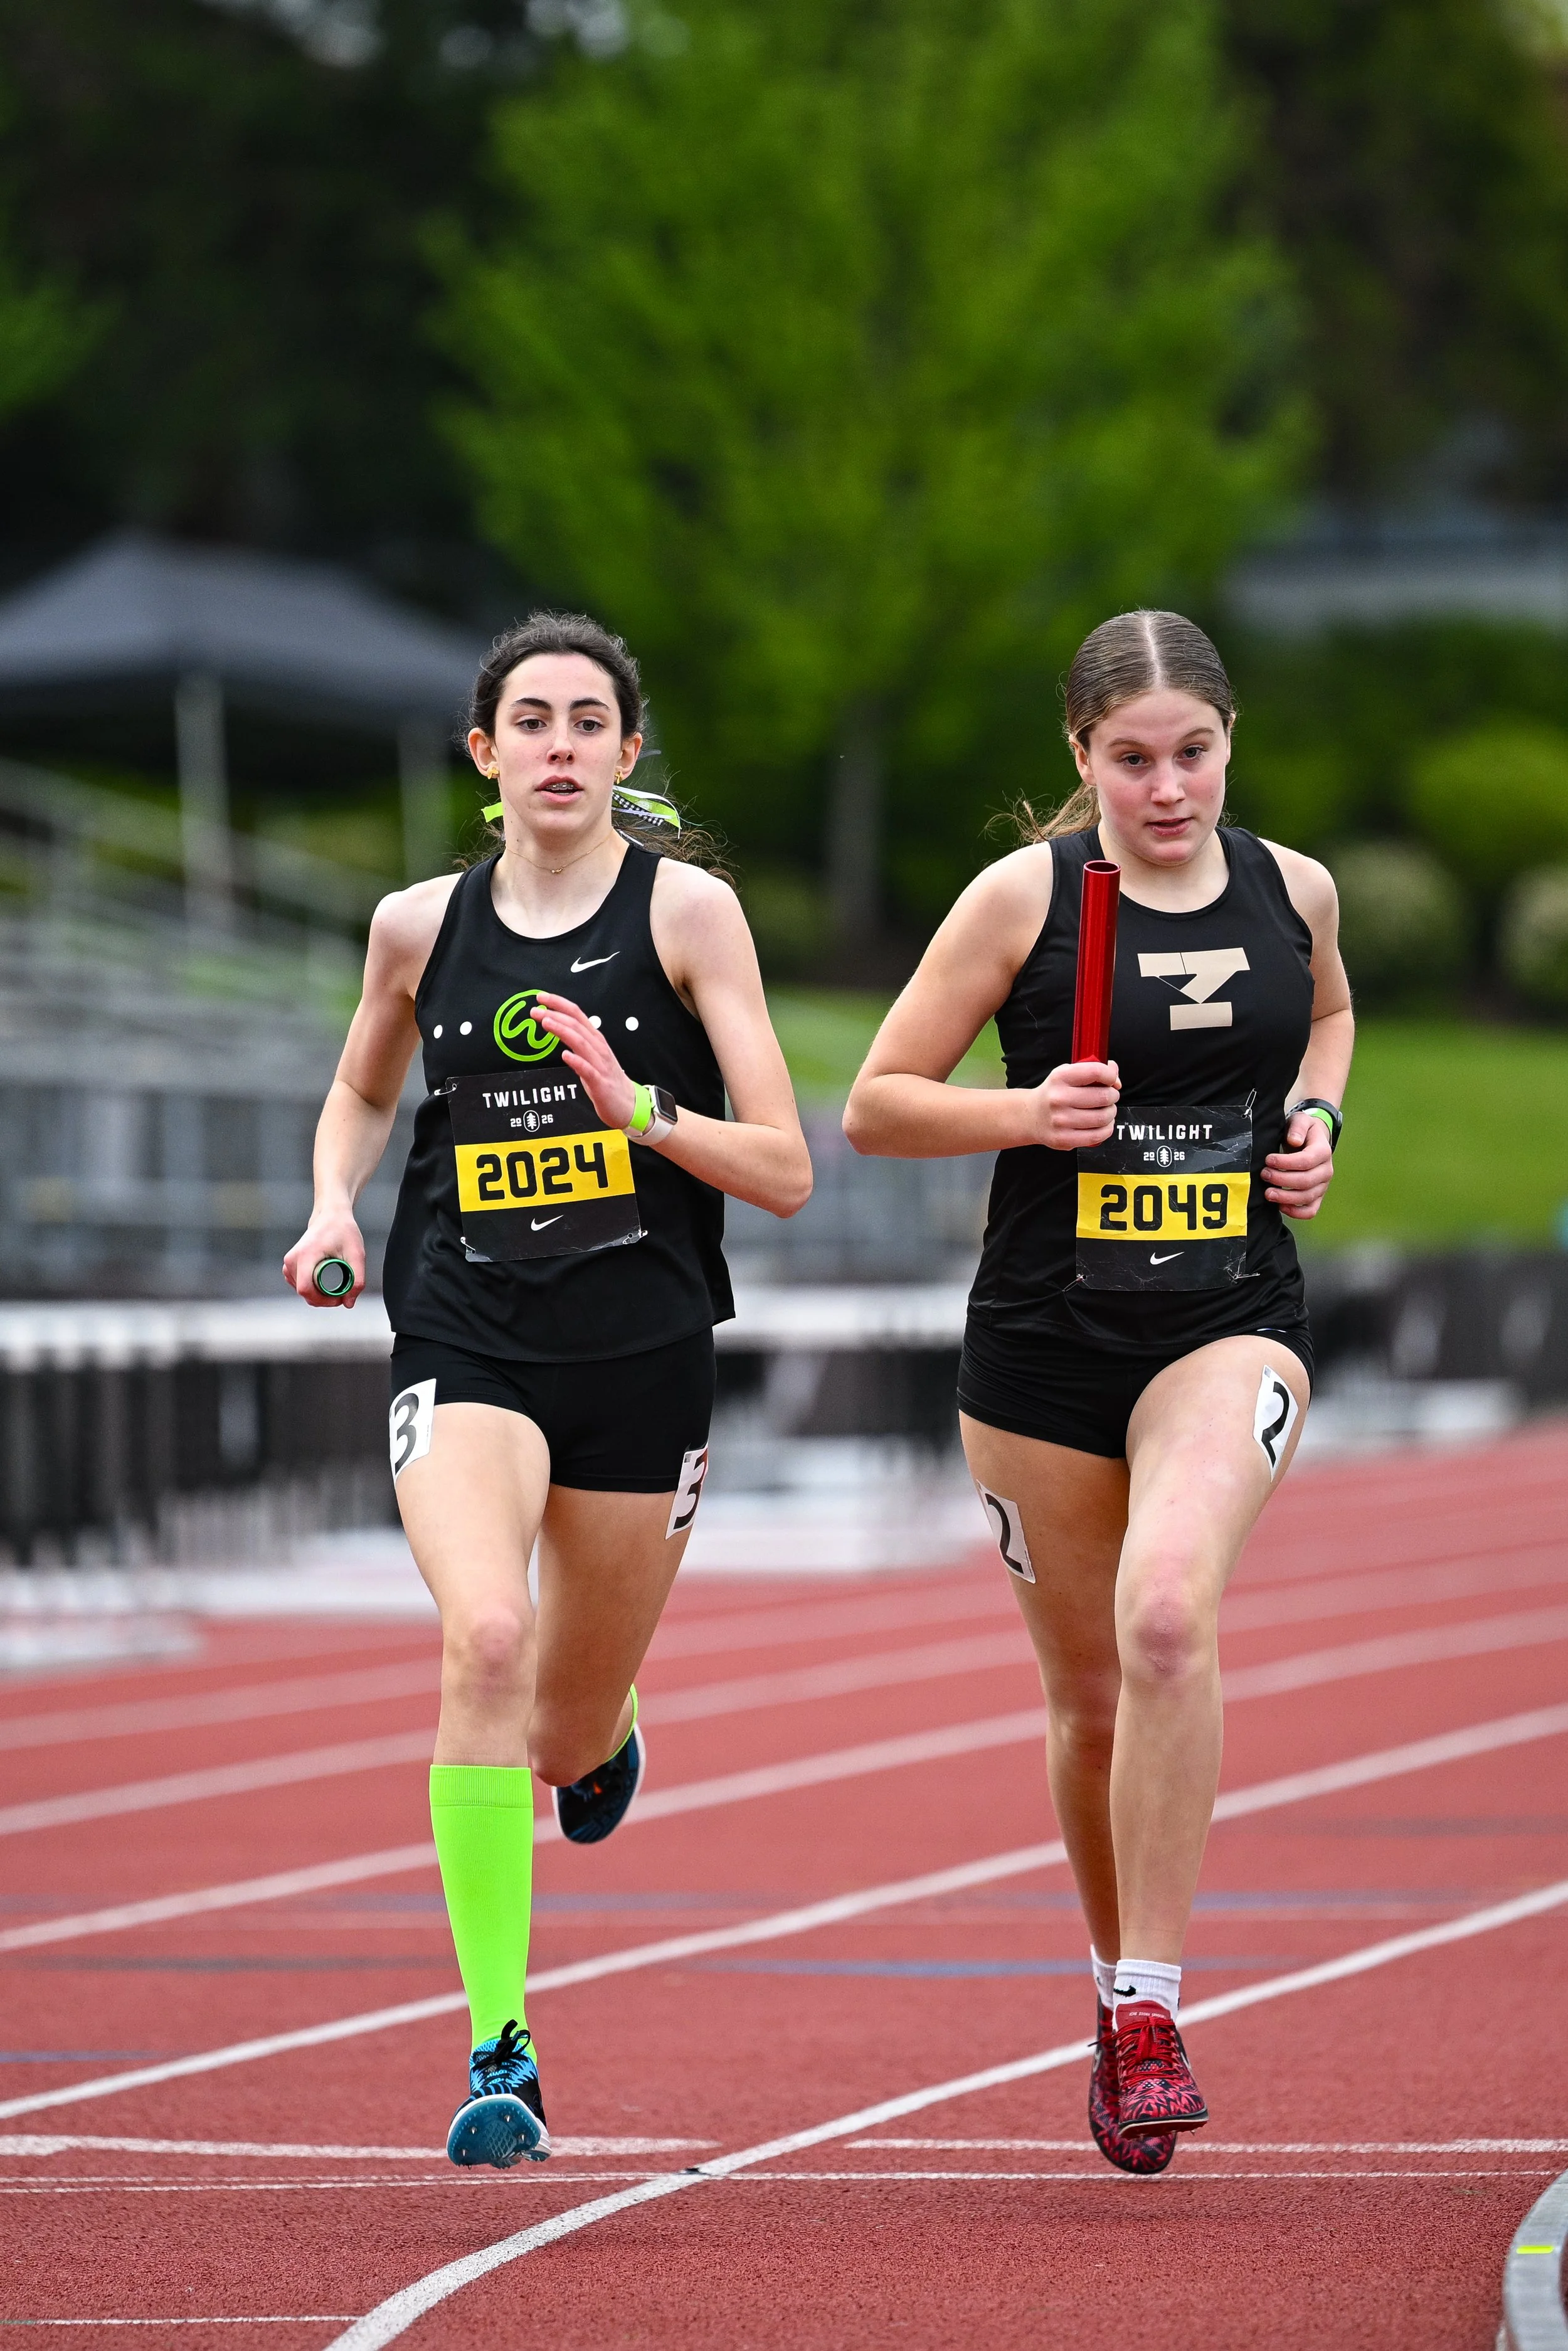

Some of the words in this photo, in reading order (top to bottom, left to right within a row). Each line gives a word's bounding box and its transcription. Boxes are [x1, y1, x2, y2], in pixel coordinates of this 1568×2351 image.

[482, 1084, 578, 1108] TWILIGHT
[511, 1117, 522, 1128] 20
[542, 1114, 553, 1124] 26
[1117, 1124, 1212, 1140] TWILIGHT
[477, 1142, 608, 1201] 2024
[1143, 1152, 1155, 1161] 20
[1173, 1151, 1185, 1160] 26
[1099, 1184, 1229, 1231] 2049
[395, 1393, 419, 1475] 3
[1261, 1381, 1290, 1468] 2
[985, 1493, 1024, 1573] 2
